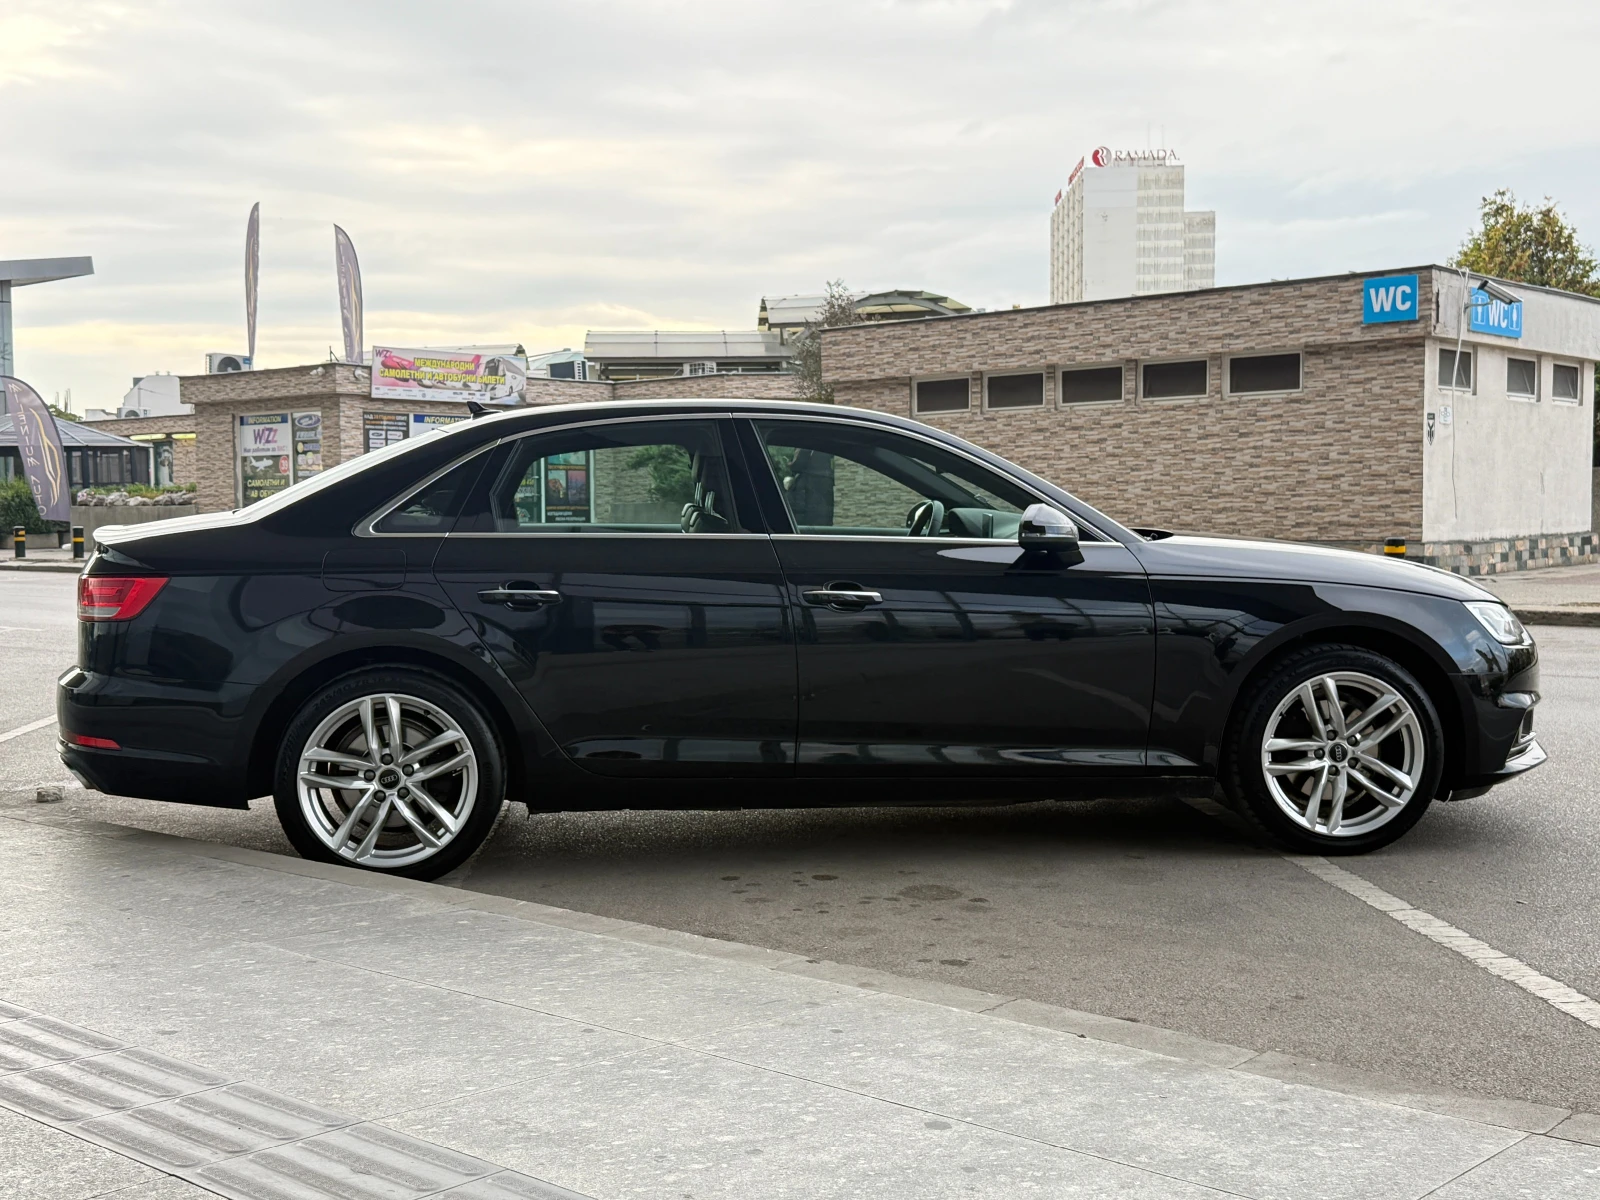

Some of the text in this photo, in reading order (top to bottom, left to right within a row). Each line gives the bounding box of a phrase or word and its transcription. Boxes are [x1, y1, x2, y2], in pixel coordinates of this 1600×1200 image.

[1115, 149, 1177, 161] RAMADA
[1369, 285, 1411, 313] WC
[1488, 300, 1508, 329] WC
[414, 358, 475, 370] МЕЖДУНАРОДНИ
[379, 368, 425, 379] САМОЛЕТНИ
[434, 373, 476, 382] АВТОБУСНИ
[478, 375, 506, 384] БИЛЕТИ
